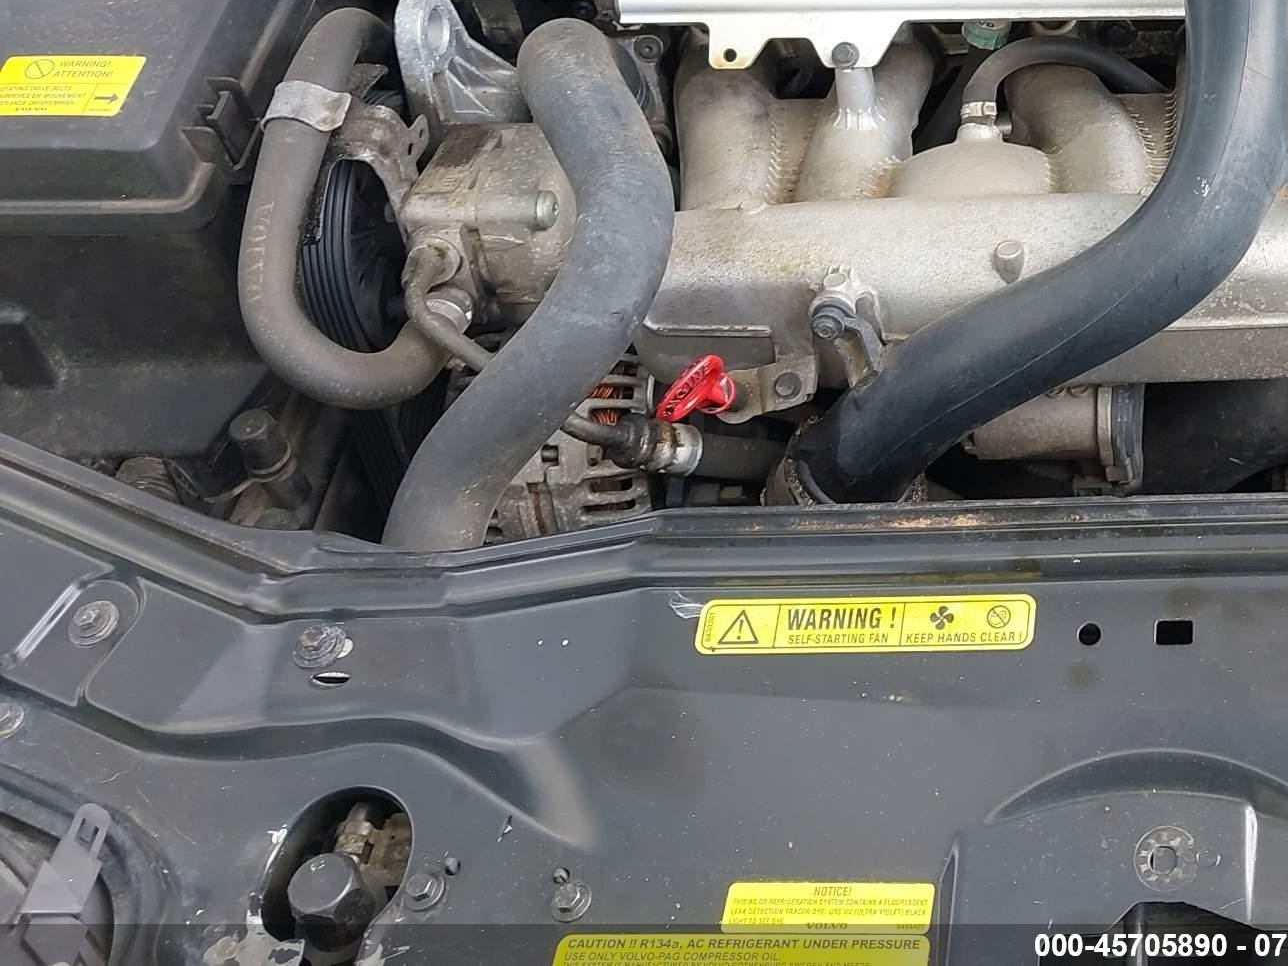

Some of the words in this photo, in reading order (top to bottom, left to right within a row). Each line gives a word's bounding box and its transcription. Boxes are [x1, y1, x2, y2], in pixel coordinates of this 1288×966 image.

[59, 60, 112, 68] WARNING!
[53, 70, 114, 78] ATTENTION!
[787, 607, 881, 631] WARNING
[787, 633, 866, 645] SELF-STARTING
[868, 633, 889, 644] FAN
[906, 633, 934, 643] KEEP
[936, 632, 976, 643] HANDS
[980, 631, 1015, 642] CLEAR
[814, 886, 852, 896] NOTICE!
[806, 922, 848, 930] VOLVO
[568, 939, 625, 949] CAUTION
[640, 939, 682, 950] R134a,
[686, 939, 706, 949] AC
[708, 939, 799, 949] REFRIGERANT
[803, 939, 848, 949] UNDER
[852, 939, 920, 949] PRESSURE
[565, 952, 586, 961] USE
[588, 952, 617, 961] ONLY
[619, 952, 681, 961] VOLVO-PAG
[683, 952, 759, 961] COMPRESSOR
